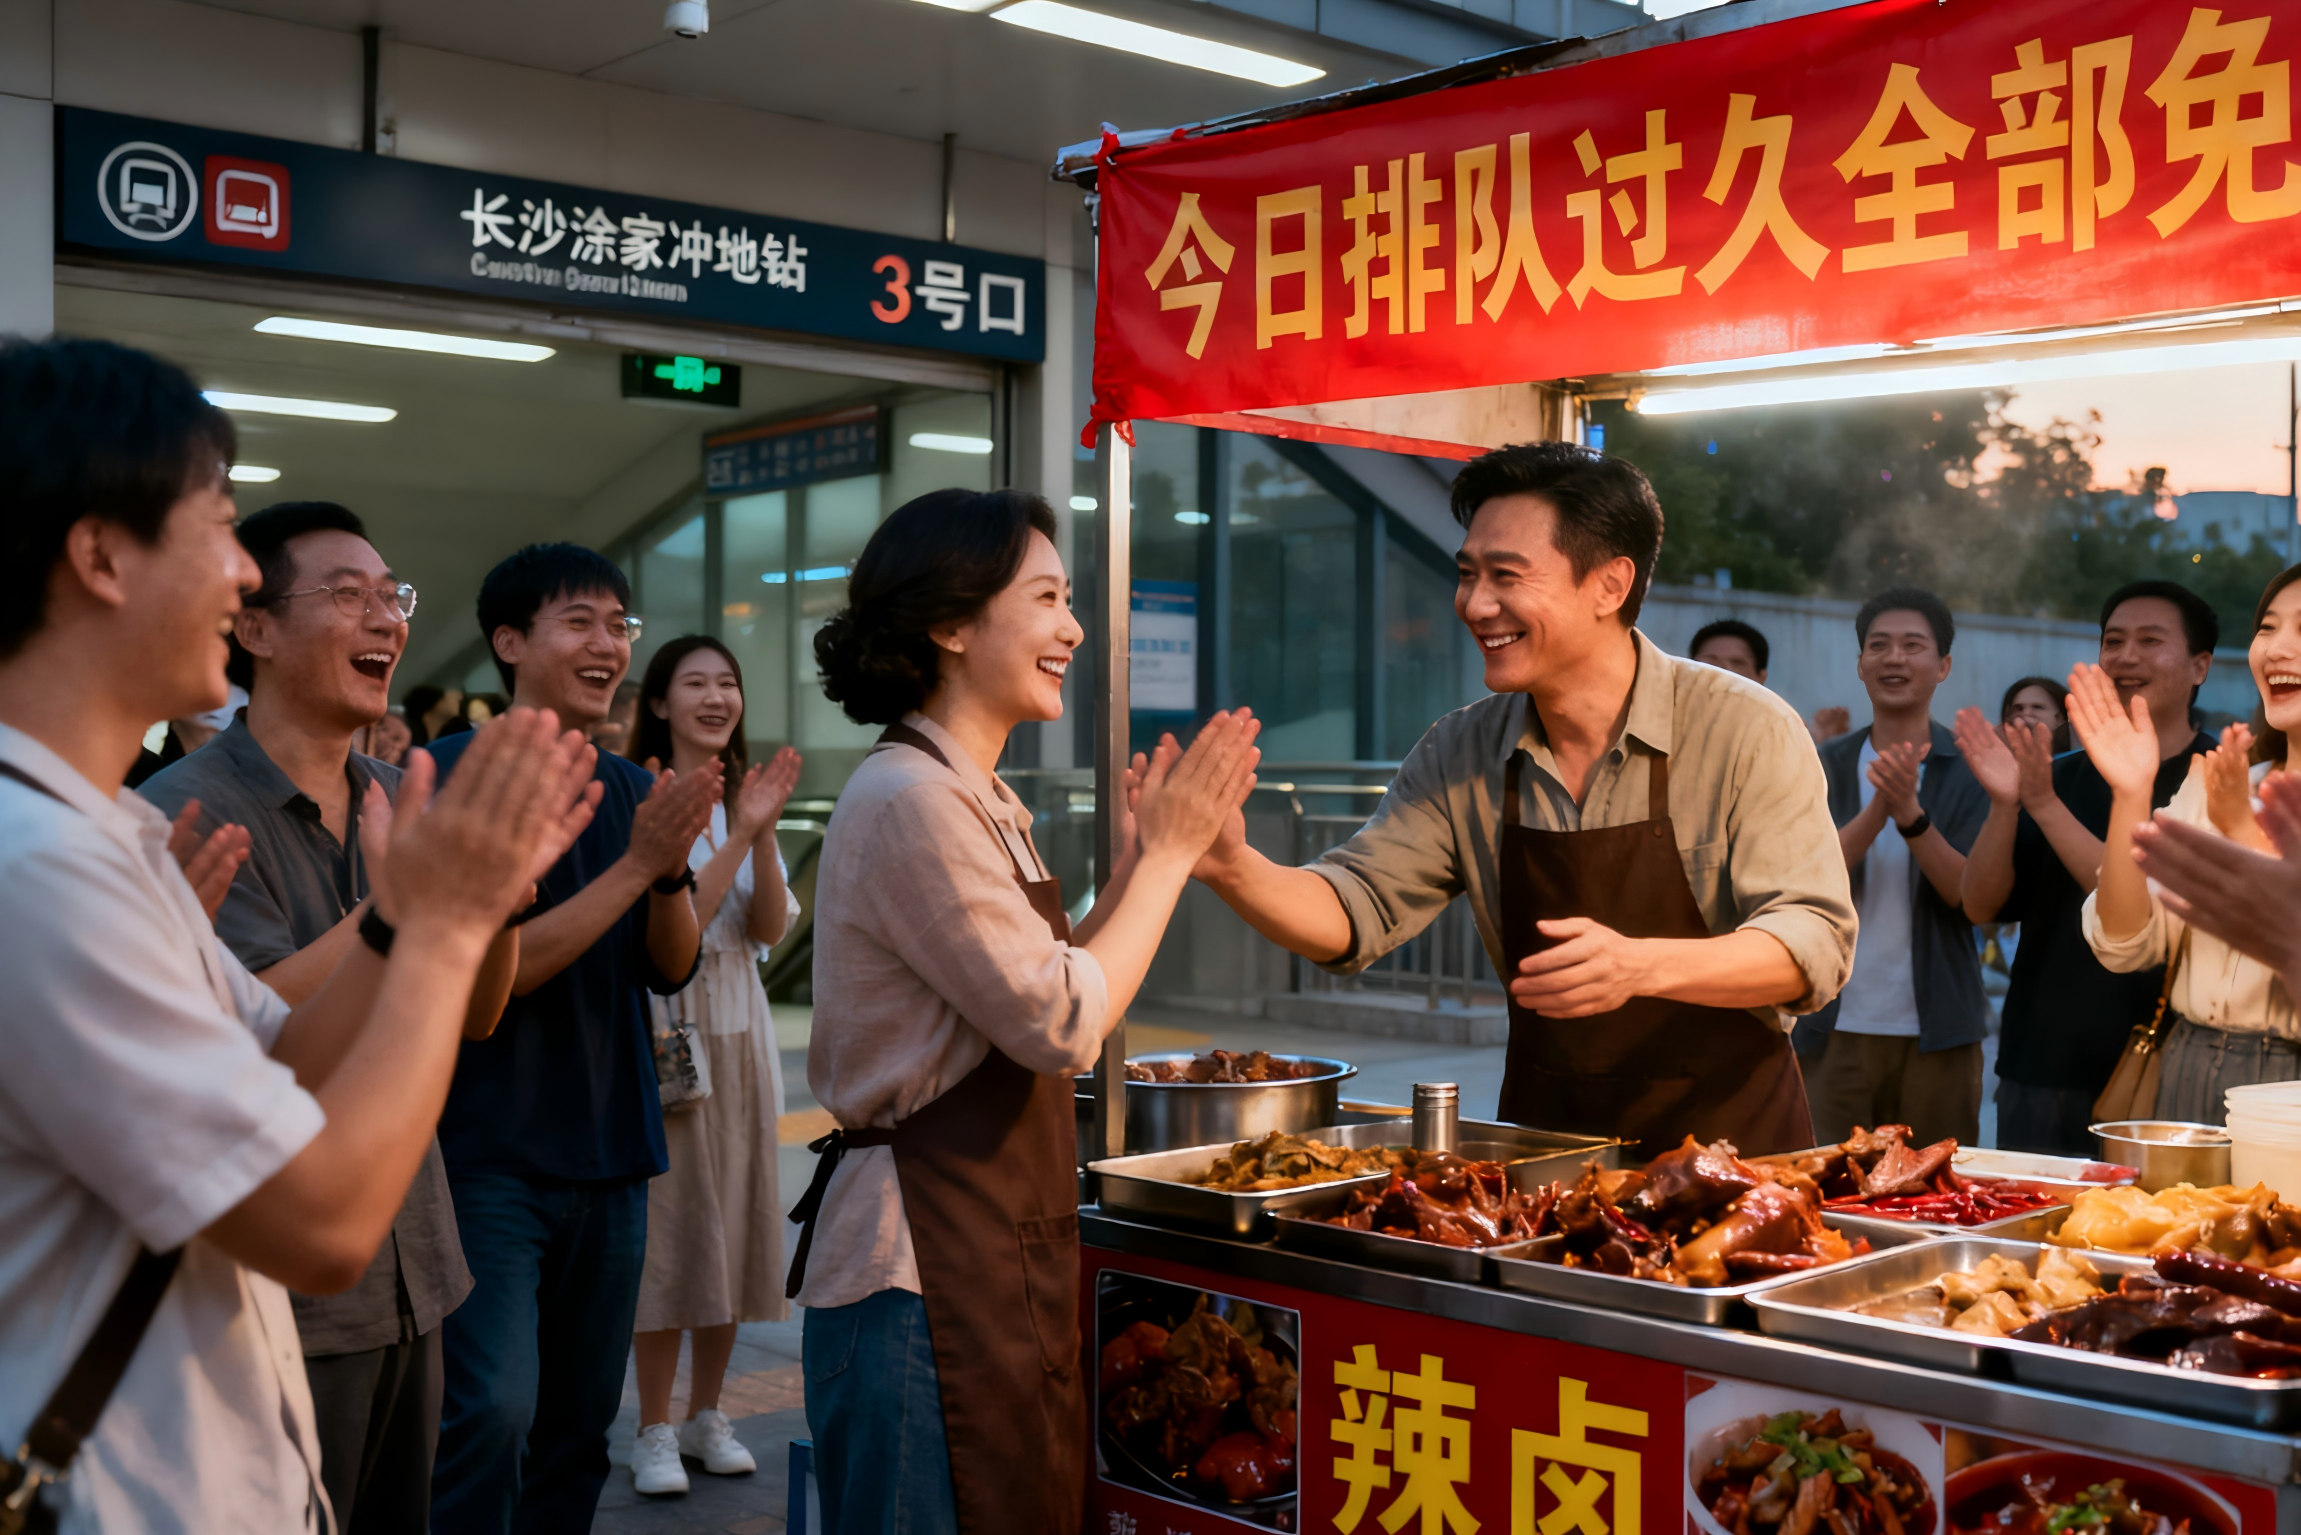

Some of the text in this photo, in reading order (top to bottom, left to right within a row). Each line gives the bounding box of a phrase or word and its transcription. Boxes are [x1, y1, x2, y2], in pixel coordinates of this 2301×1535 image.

[1144, 7, 2301, 360] 今日排队过久全部免
[869, 254, 1025, 336] 3号口
[1330, 1344, 1649, 1535] 辣卤
